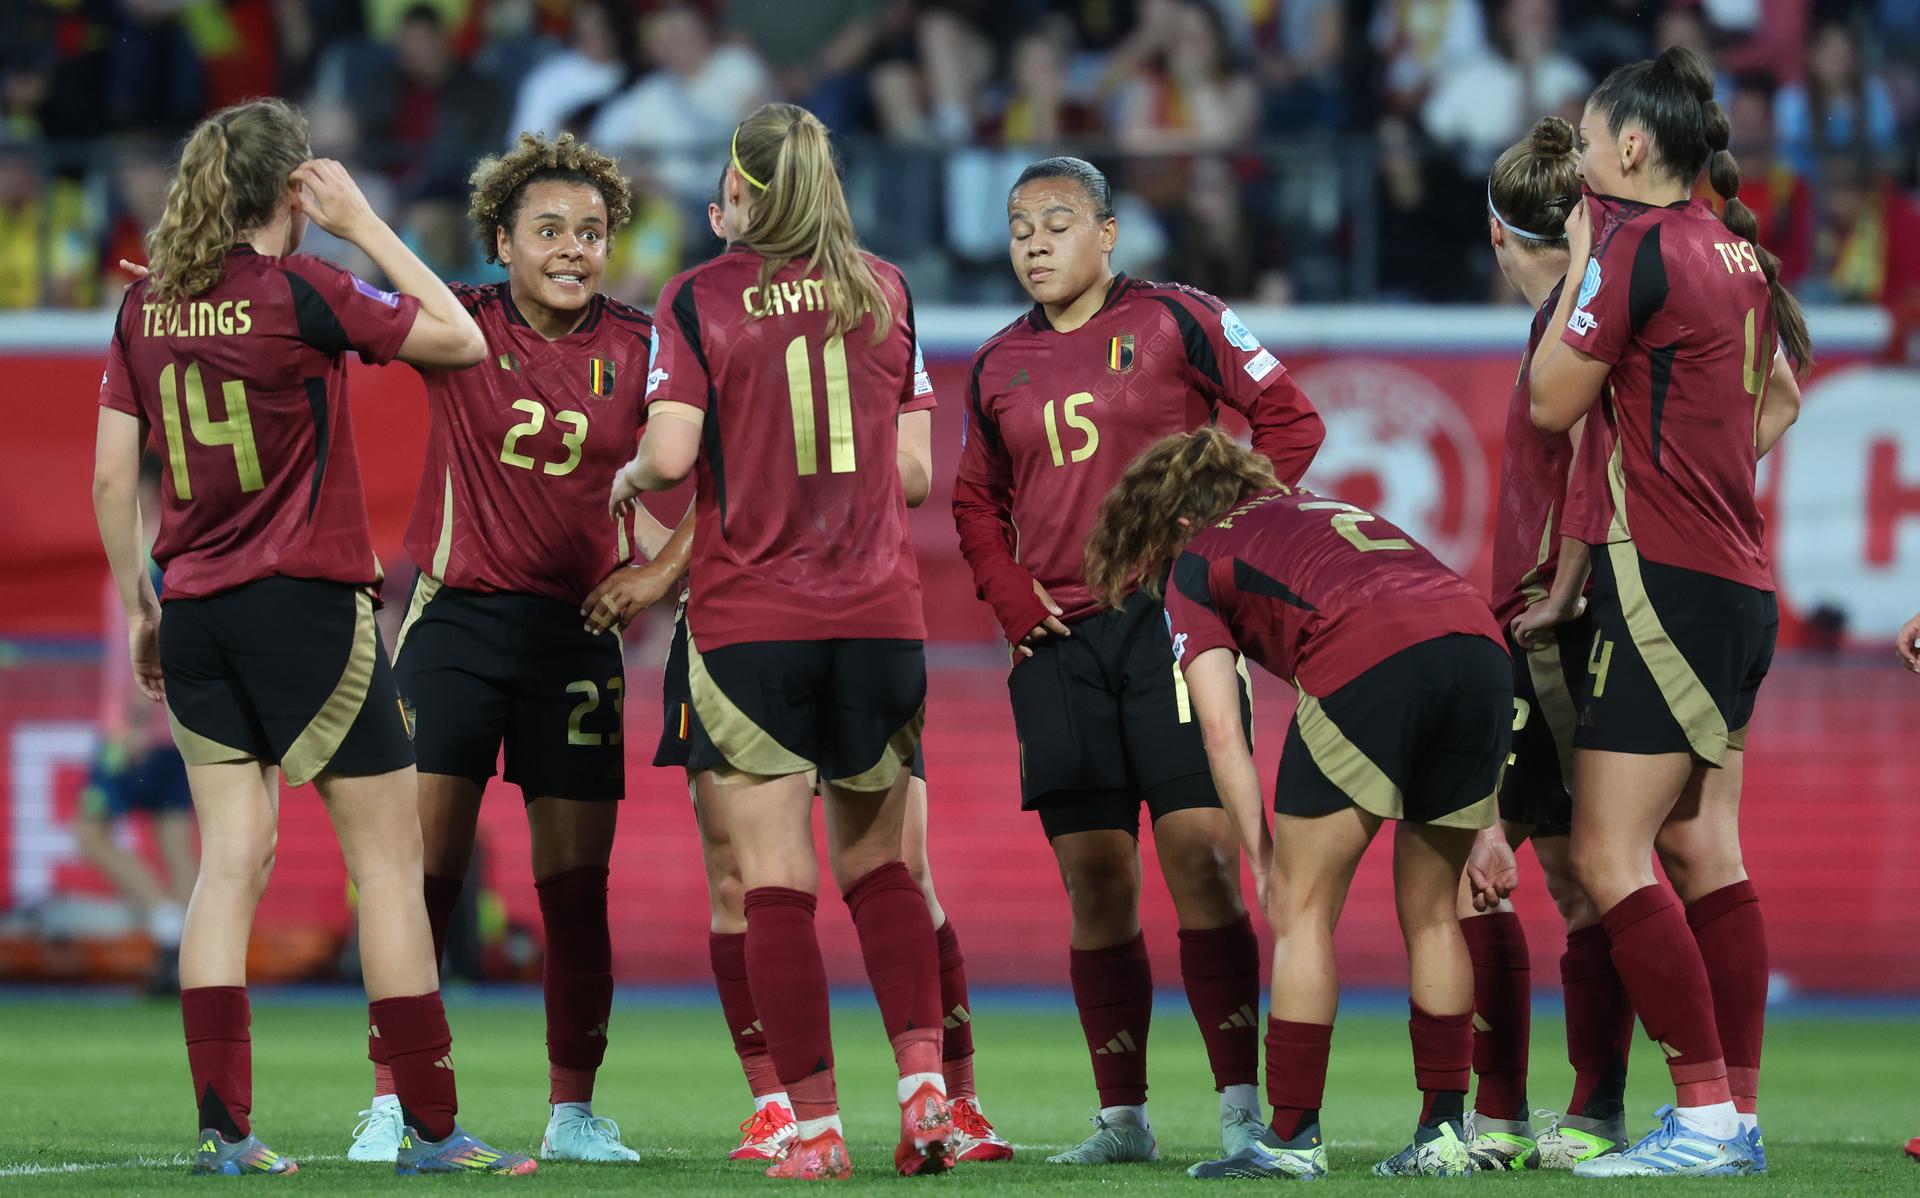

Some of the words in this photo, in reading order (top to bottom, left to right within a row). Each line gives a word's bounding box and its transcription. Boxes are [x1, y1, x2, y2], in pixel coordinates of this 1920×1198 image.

[143, 300, 252, 338] TEULINGS
[742, 278, 872, 318] CAYM
[159, 361, 266, 500] 14
[499, 398, 589, 477] 23
[785, 335, 857, 477] 11
[1043, 391, 1100, 468] 15
[1297, 500, 1415, 553] 2
[1587, 628, 1615, 698] 4
